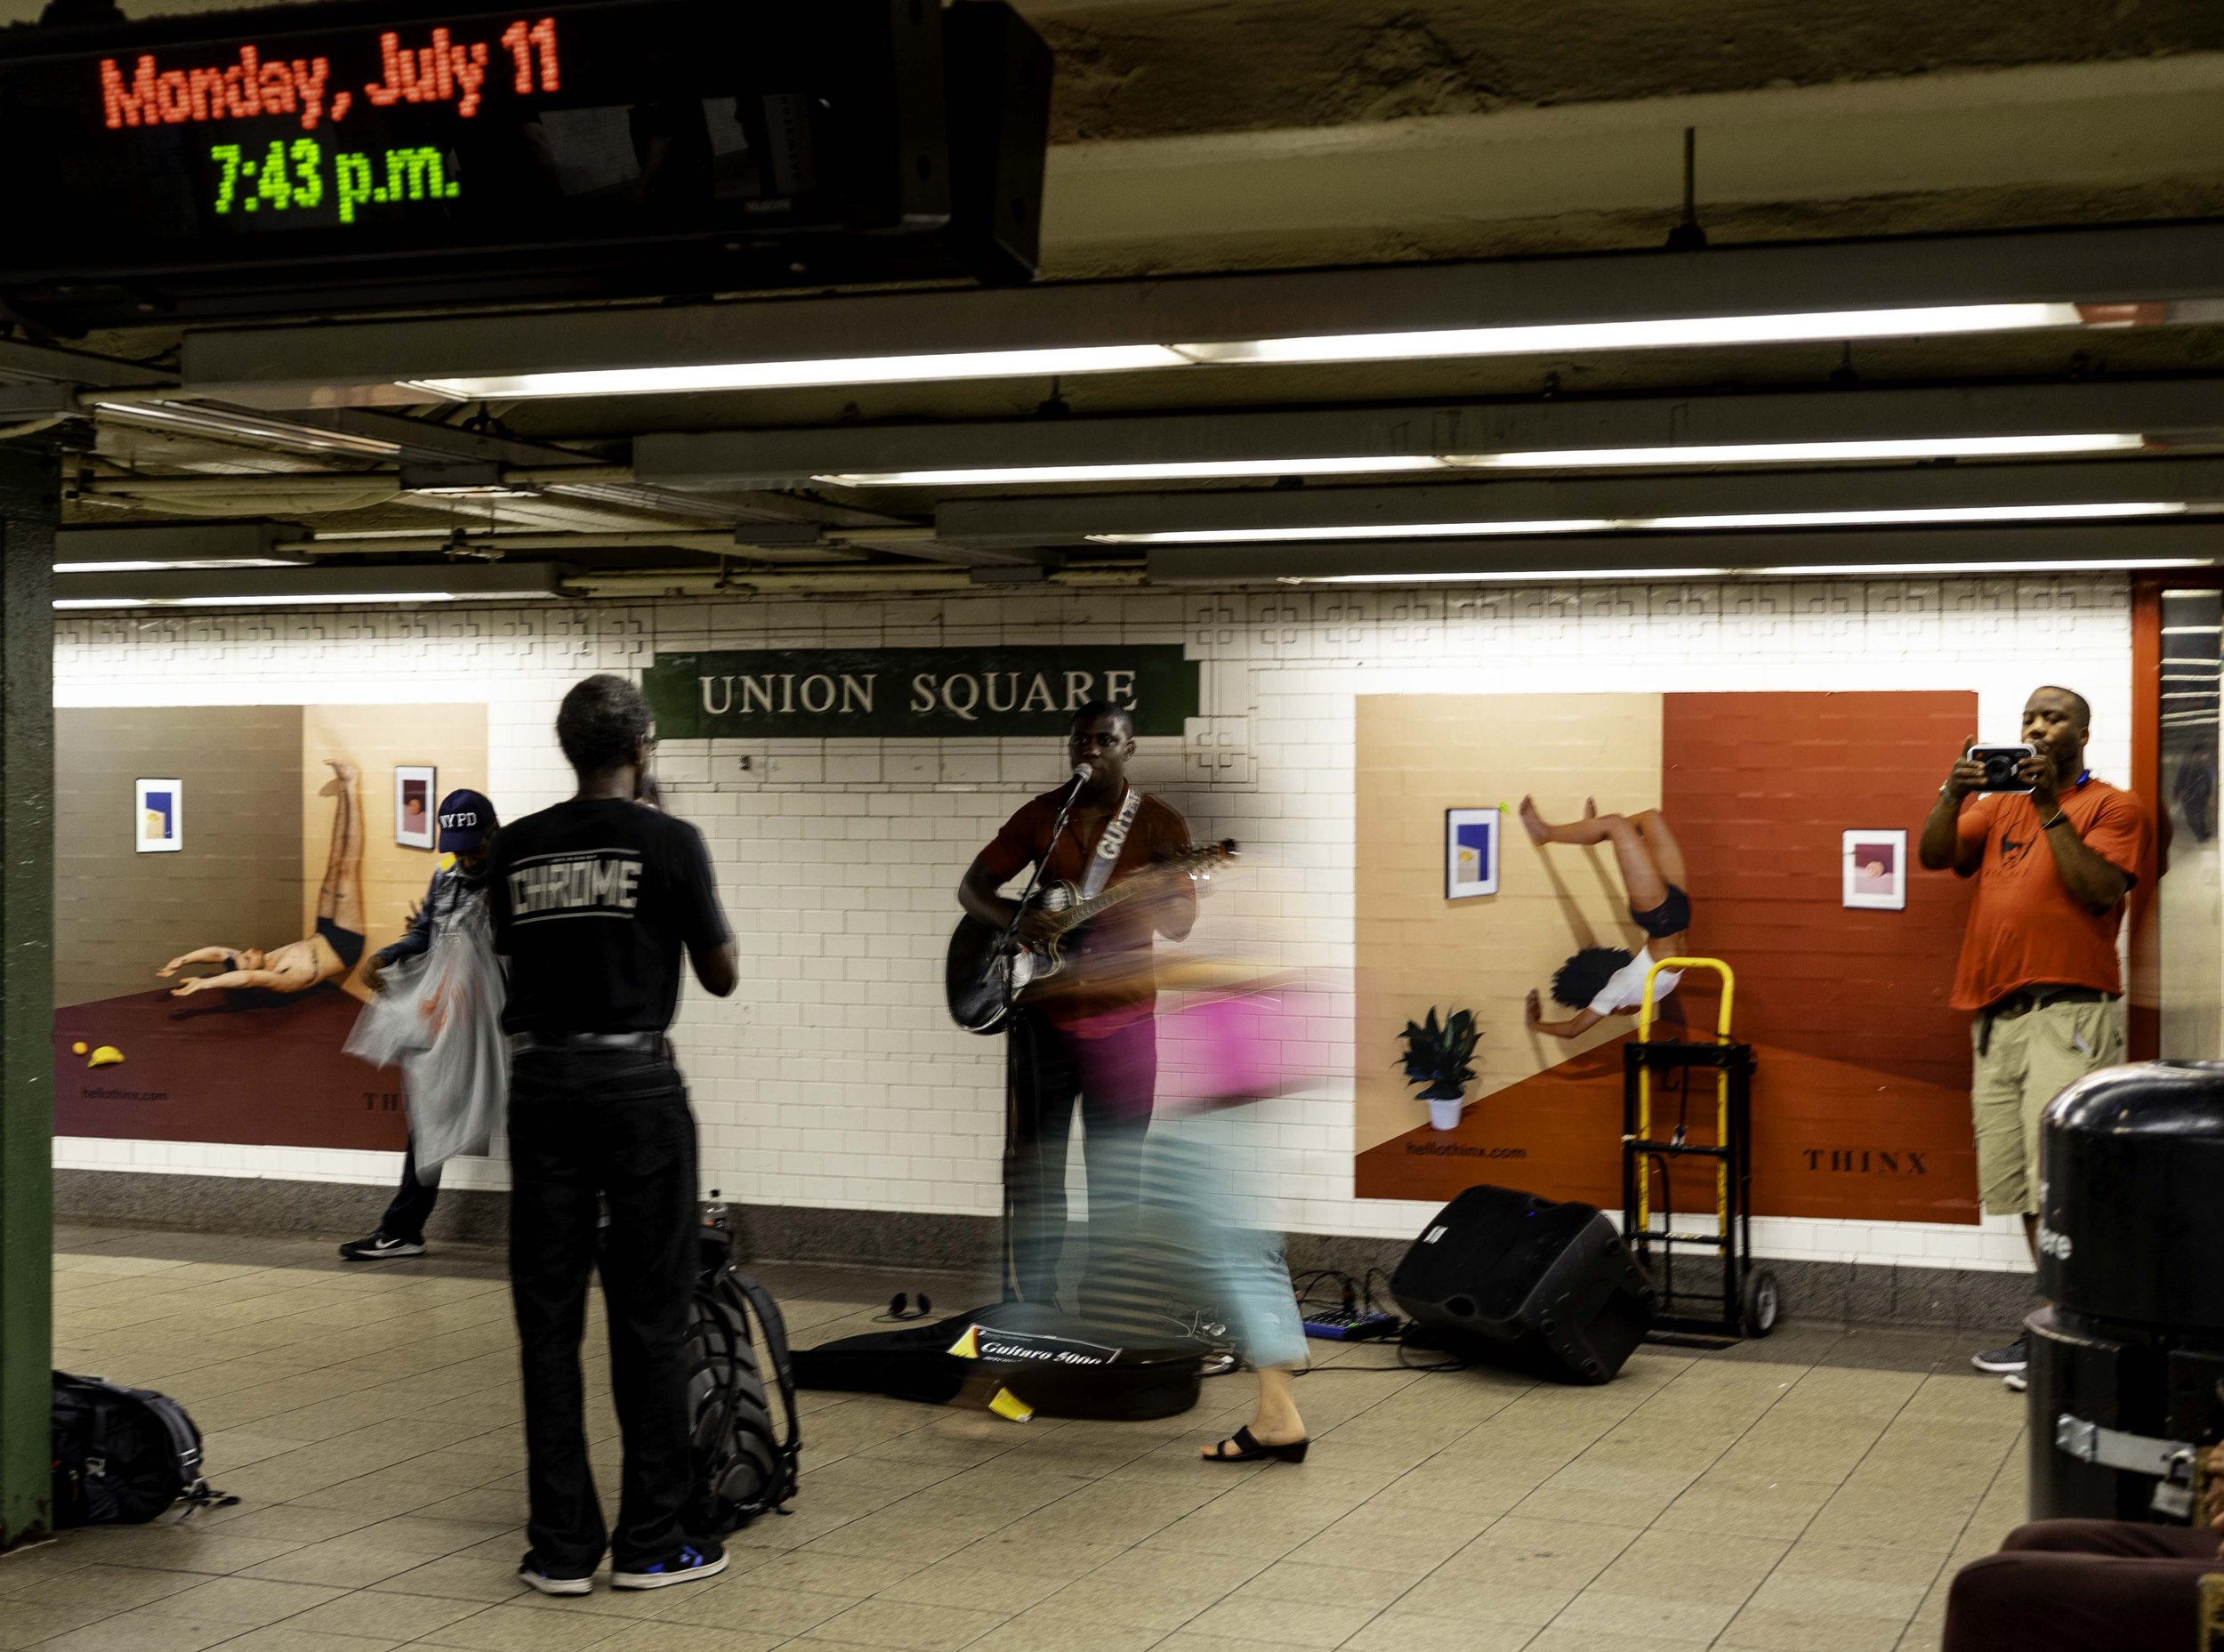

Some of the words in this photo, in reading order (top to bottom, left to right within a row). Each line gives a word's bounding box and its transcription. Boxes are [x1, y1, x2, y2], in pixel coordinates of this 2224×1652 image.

[101, 45, 351, 129] Monday,
[365, 28, 488, 117] July
[502, 18, 560, 92] 11
[211, 139, 323, 214] 7:43
[335, 147, 460, 223] p.m.
[699, 673, 877, 713] UNION
[909, 669, 1137, 721] SQUARE
[439, 812, 478, 828] NYPD
[507, 859, 643, 915] CHROME
[363, 1092, 411, 1111] THI
[1406, 1140, 1527, 1159] hellothinx.com
[1802, 1148, 1927, 1174] THINX
[980, 1342, 1053, 1360] Guitaro
